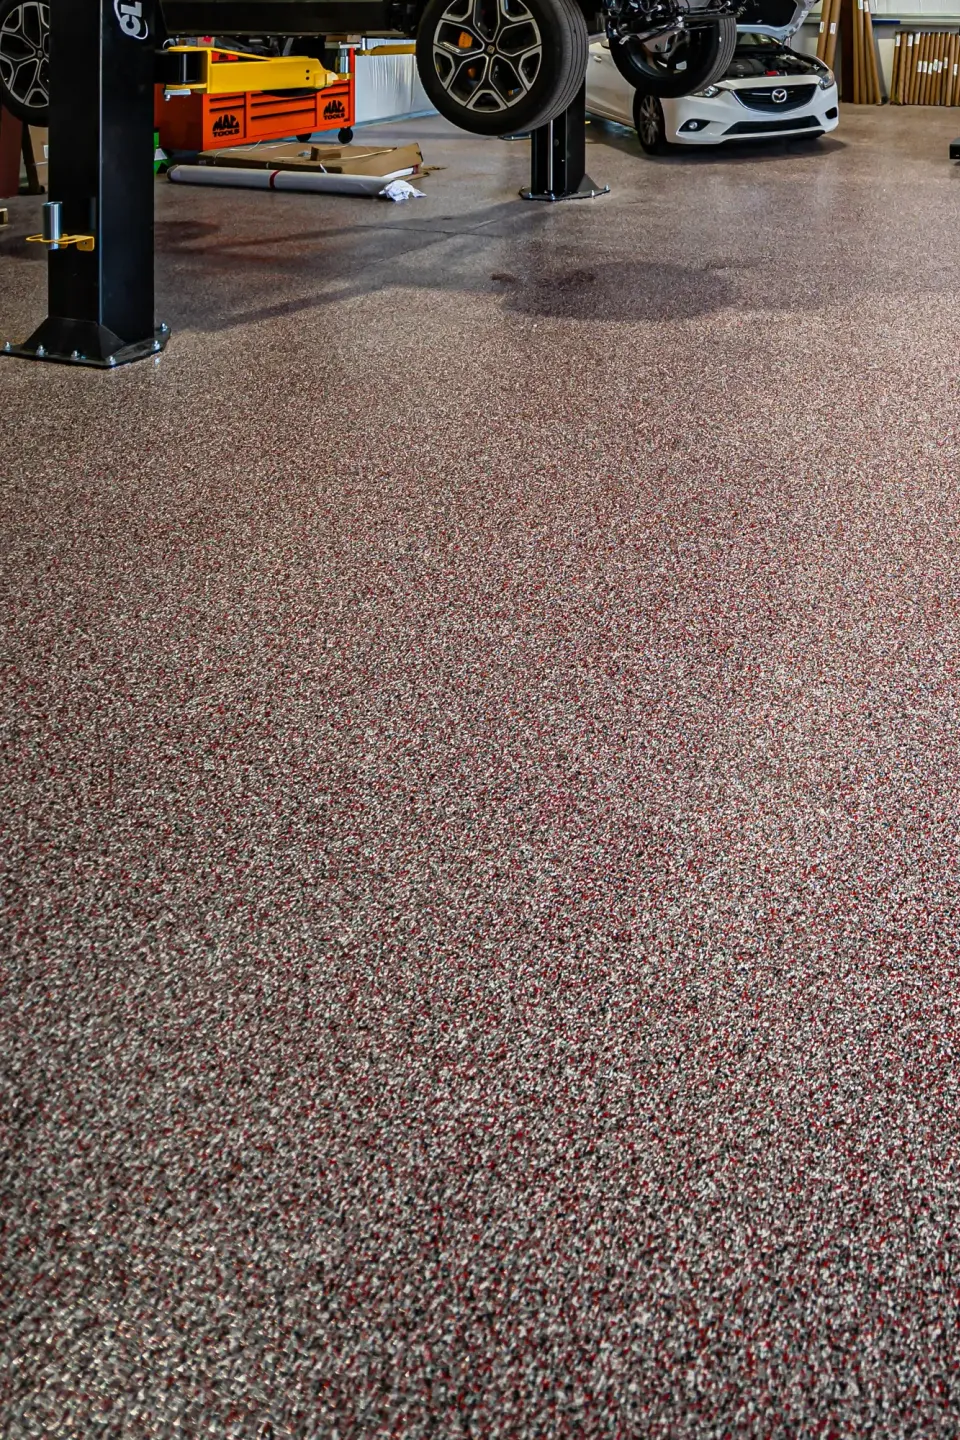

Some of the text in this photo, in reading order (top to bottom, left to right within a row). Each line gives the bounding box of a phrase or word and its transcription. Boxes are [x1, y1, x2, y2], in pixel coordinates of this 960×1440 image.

[323, 99, 345, 115] MAC
[212, 114, 240, 131] MAC
[323, 112, 346, 121] TOOLS
[212, 128, 240, 138] TOOLS
